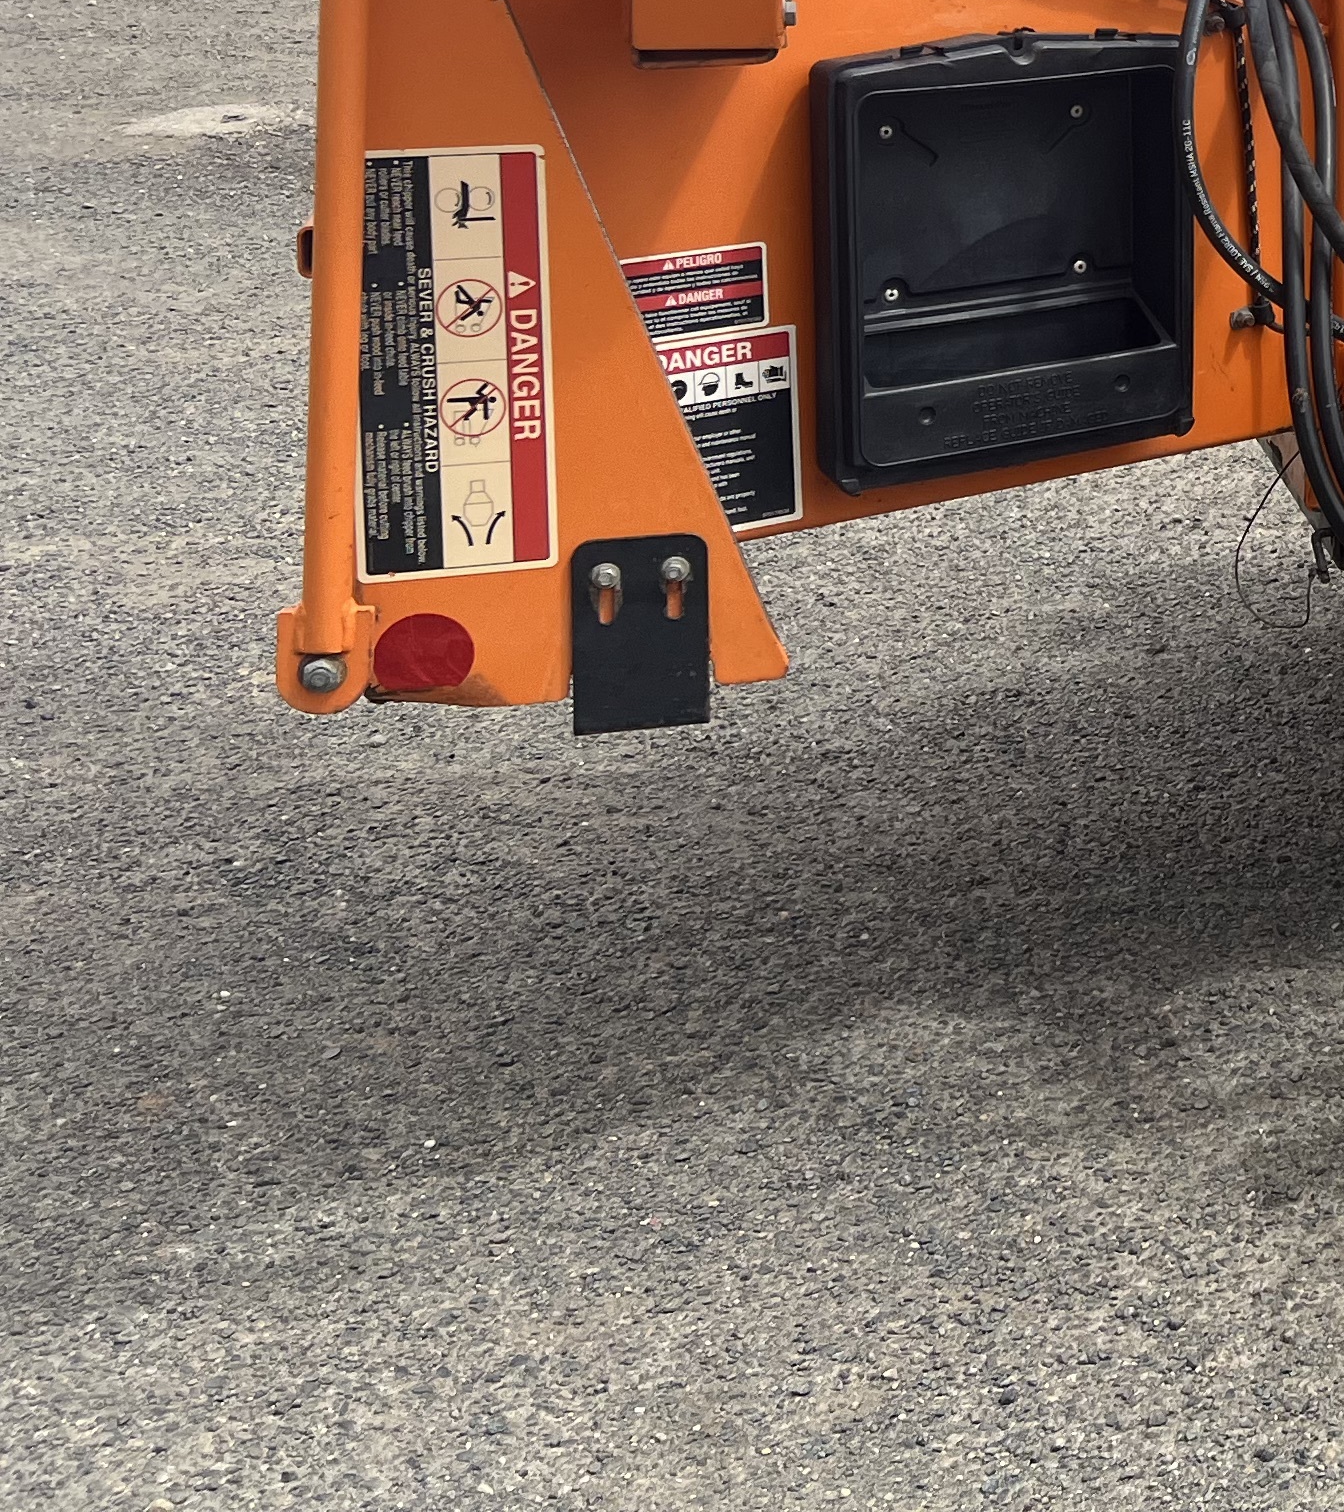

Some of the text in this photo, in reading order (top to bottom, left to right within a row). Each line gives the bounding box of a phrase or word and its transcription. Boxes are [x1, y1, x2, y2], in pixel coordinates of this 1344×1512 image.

[675, 252, 722, 269] PELIGRO
[678, 288, 723, 304] DANGER
[417, 267, 438, 473] SEVER & CRUSH HAZARD
[509, 309, 543, 441] DANGER
[712, 392, 776, 408] PERSONNEL ONLY
